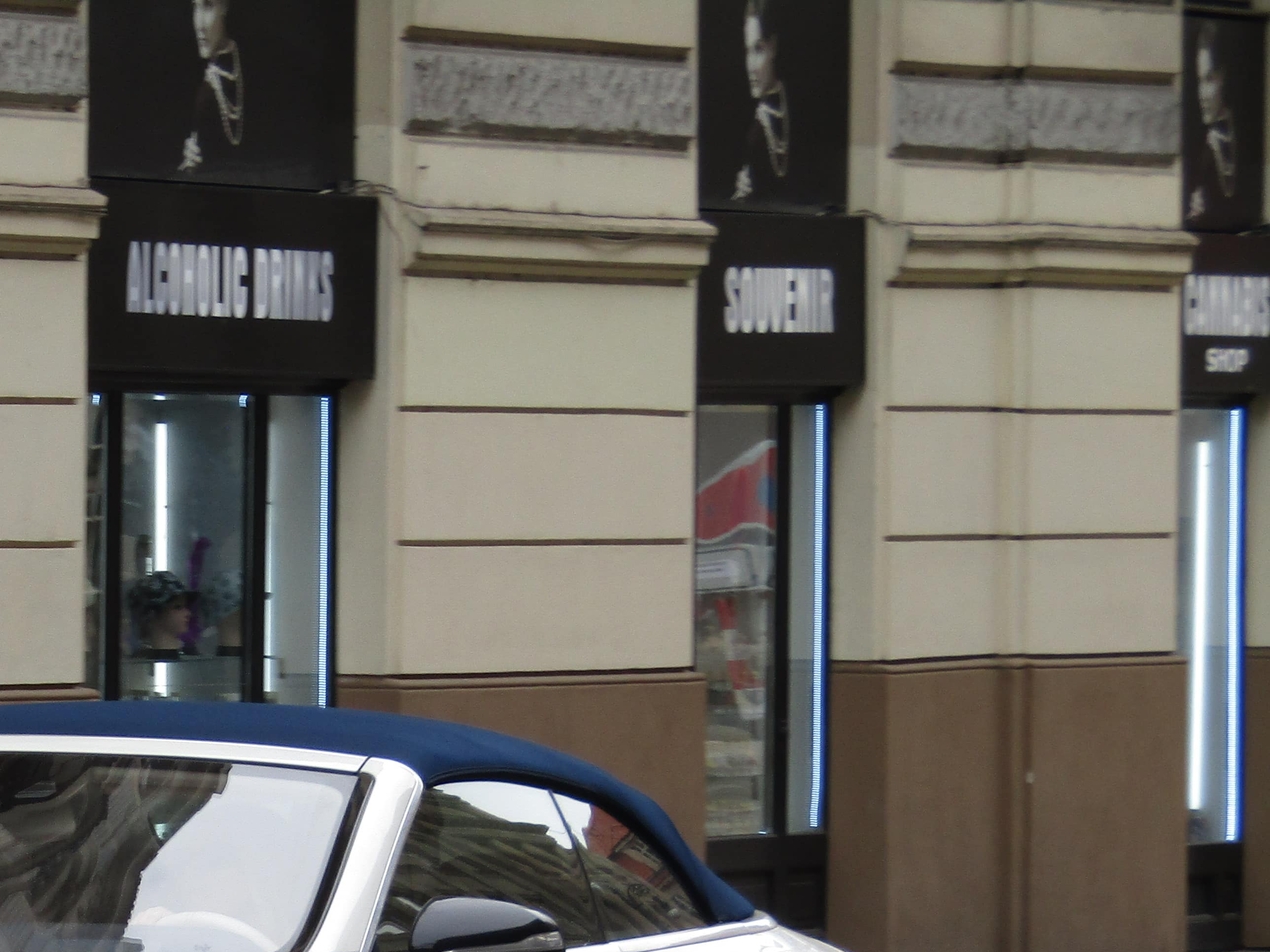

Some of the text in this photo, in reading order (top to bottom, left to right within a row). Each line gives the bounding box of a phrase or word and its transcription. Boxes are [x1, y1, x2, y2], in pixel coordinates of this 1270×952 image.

[126, 241, 335, 322] ALCOHOLIC DRINKS
[723, 266, 835, 333] SOUVENIR
[1205, 348, 1250, 373] SHOP
